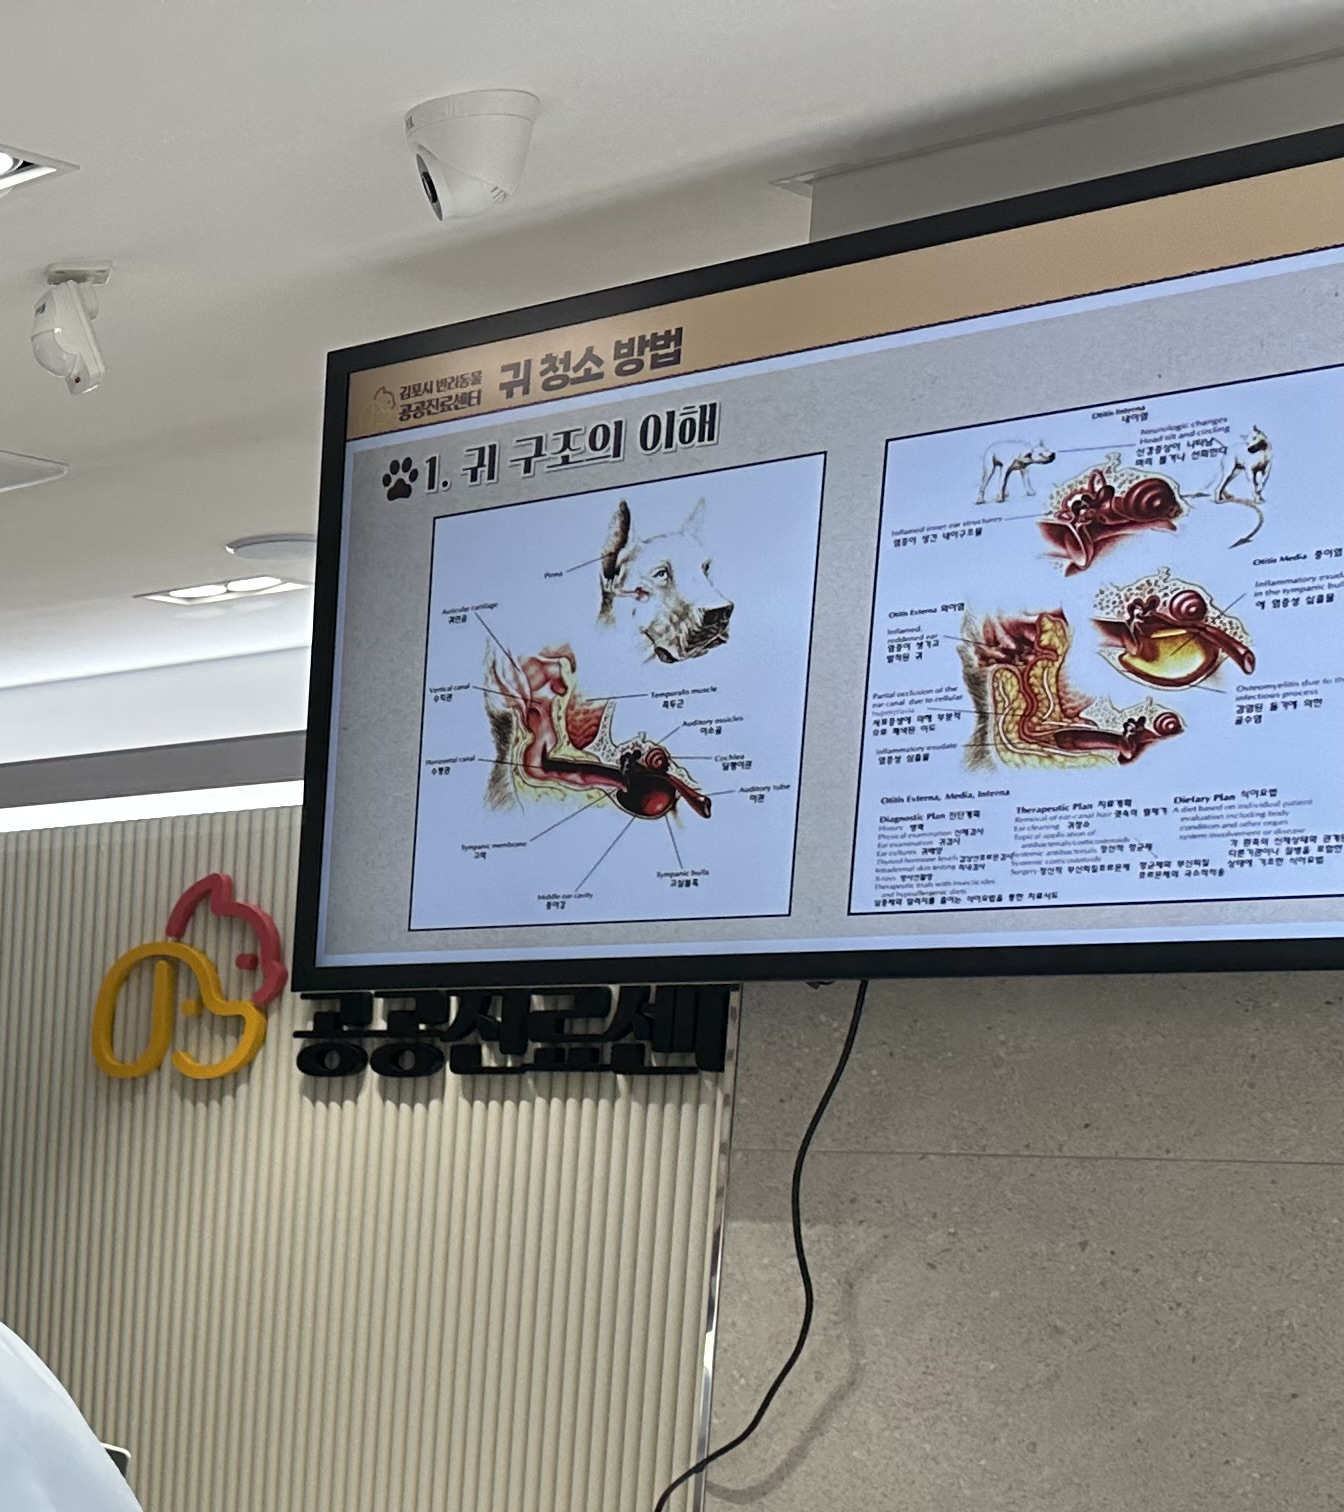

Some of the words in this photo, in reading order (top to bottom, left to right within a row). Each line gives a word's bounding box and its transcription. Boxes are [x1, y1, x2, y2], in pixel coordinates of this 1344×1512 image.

[499, 359, 533, 399] 귀
[540, 345, 604, 392] 청소
[614, 327, 684, 377] 방법
[425, 456, 450, 490] 1.
[463, 444, 497, 483] 귀
[510, 420, 624, 475] 구조의
[640, 402, 717, 452] 이해
